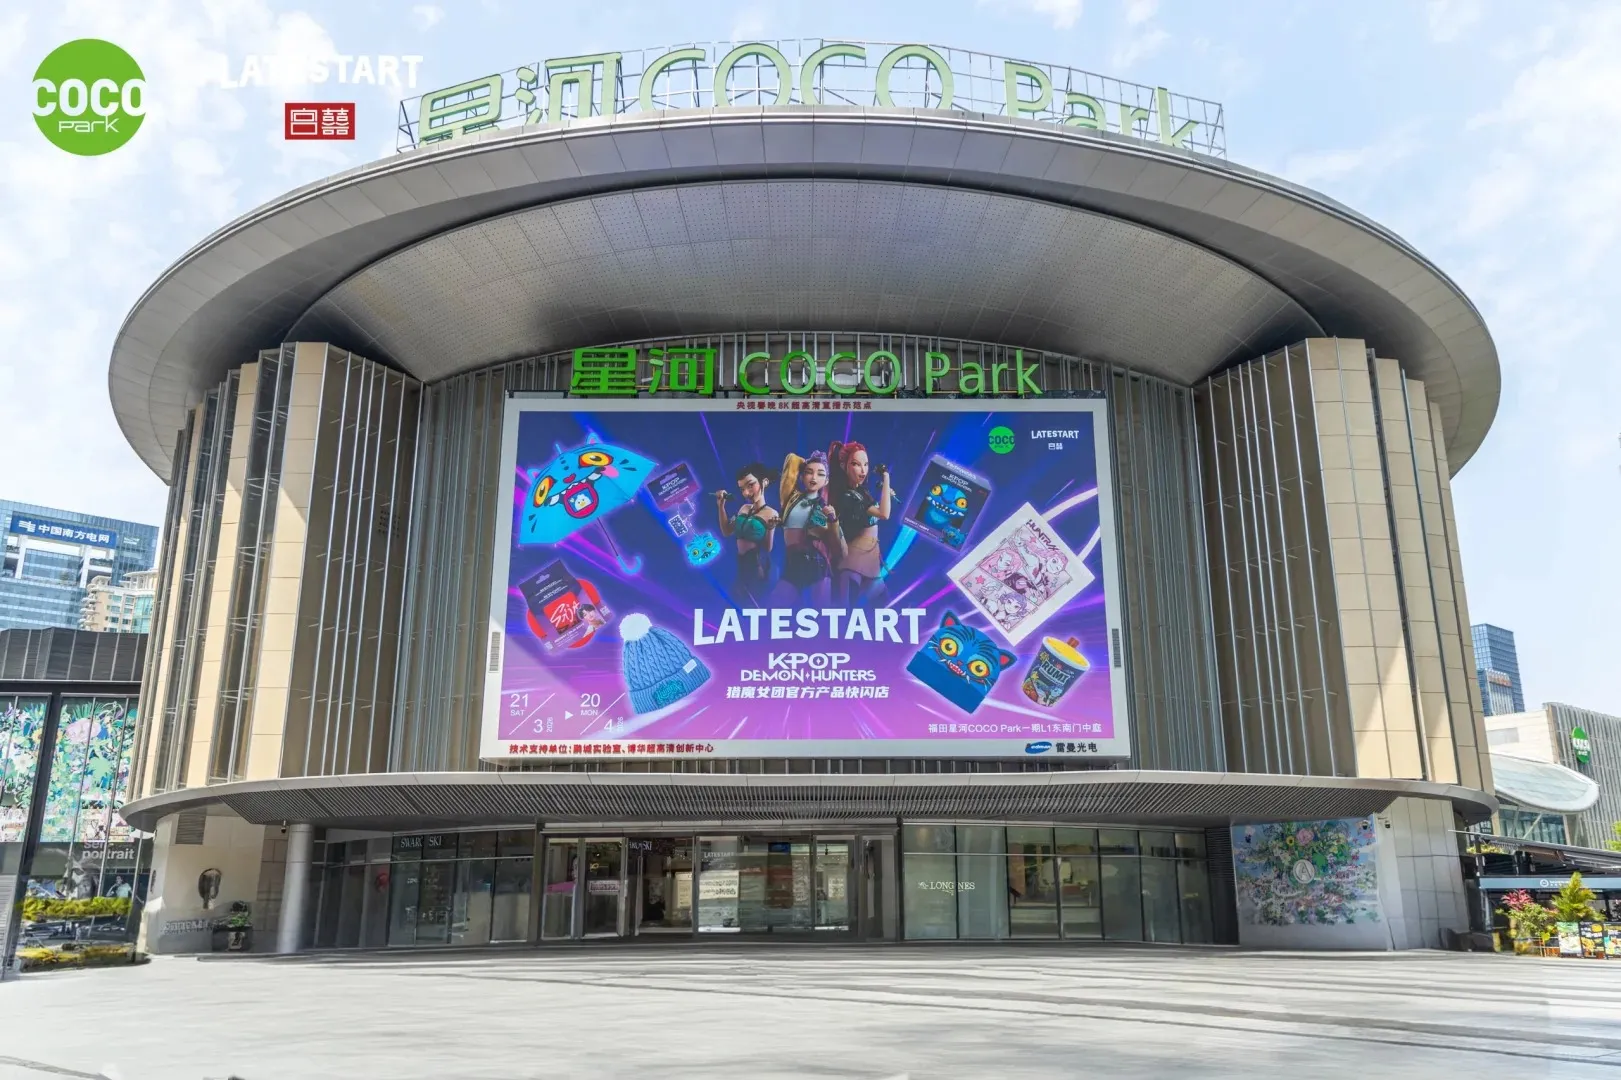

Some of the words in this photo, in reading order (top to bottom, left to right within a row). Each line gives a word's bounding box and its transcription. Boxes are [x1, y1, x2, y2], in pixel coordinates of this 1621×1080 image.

[418, 52, 623, 149] 星河
[639, 43, 954, 112] COCO
[1004, 60, 1200, 148] Park
[570, 348, 717, 395] 星河
[739, 350, 901, 395] COCO
[926, 349, 1043, 395] Park
[1031, 430, 1079, 439] LATESTART
[38, 524, 110, 544] 中国南方电网
[694, 608, 926, 645] LATESTART
[768, 652, 850, 669] KPOP
[741, 668, 804, 682] DEMON
[811, 669, 876, 683] HUNTERS
[726, 686, 889, 699] 猎魔女团官方产品快闪店
[510, 693, 528, 707] 21
[580, 693, 600, 707] 20
[533, 718, 543, 733] 3
[603, 718, 613, 733] 4
[1056, 742, 1097, 753] 雷曼光电
[400, 836, 442, 848] SWARSKI
[82, 848, 134, 860] portrait
[930, 881, 975, 890] LONGNES
